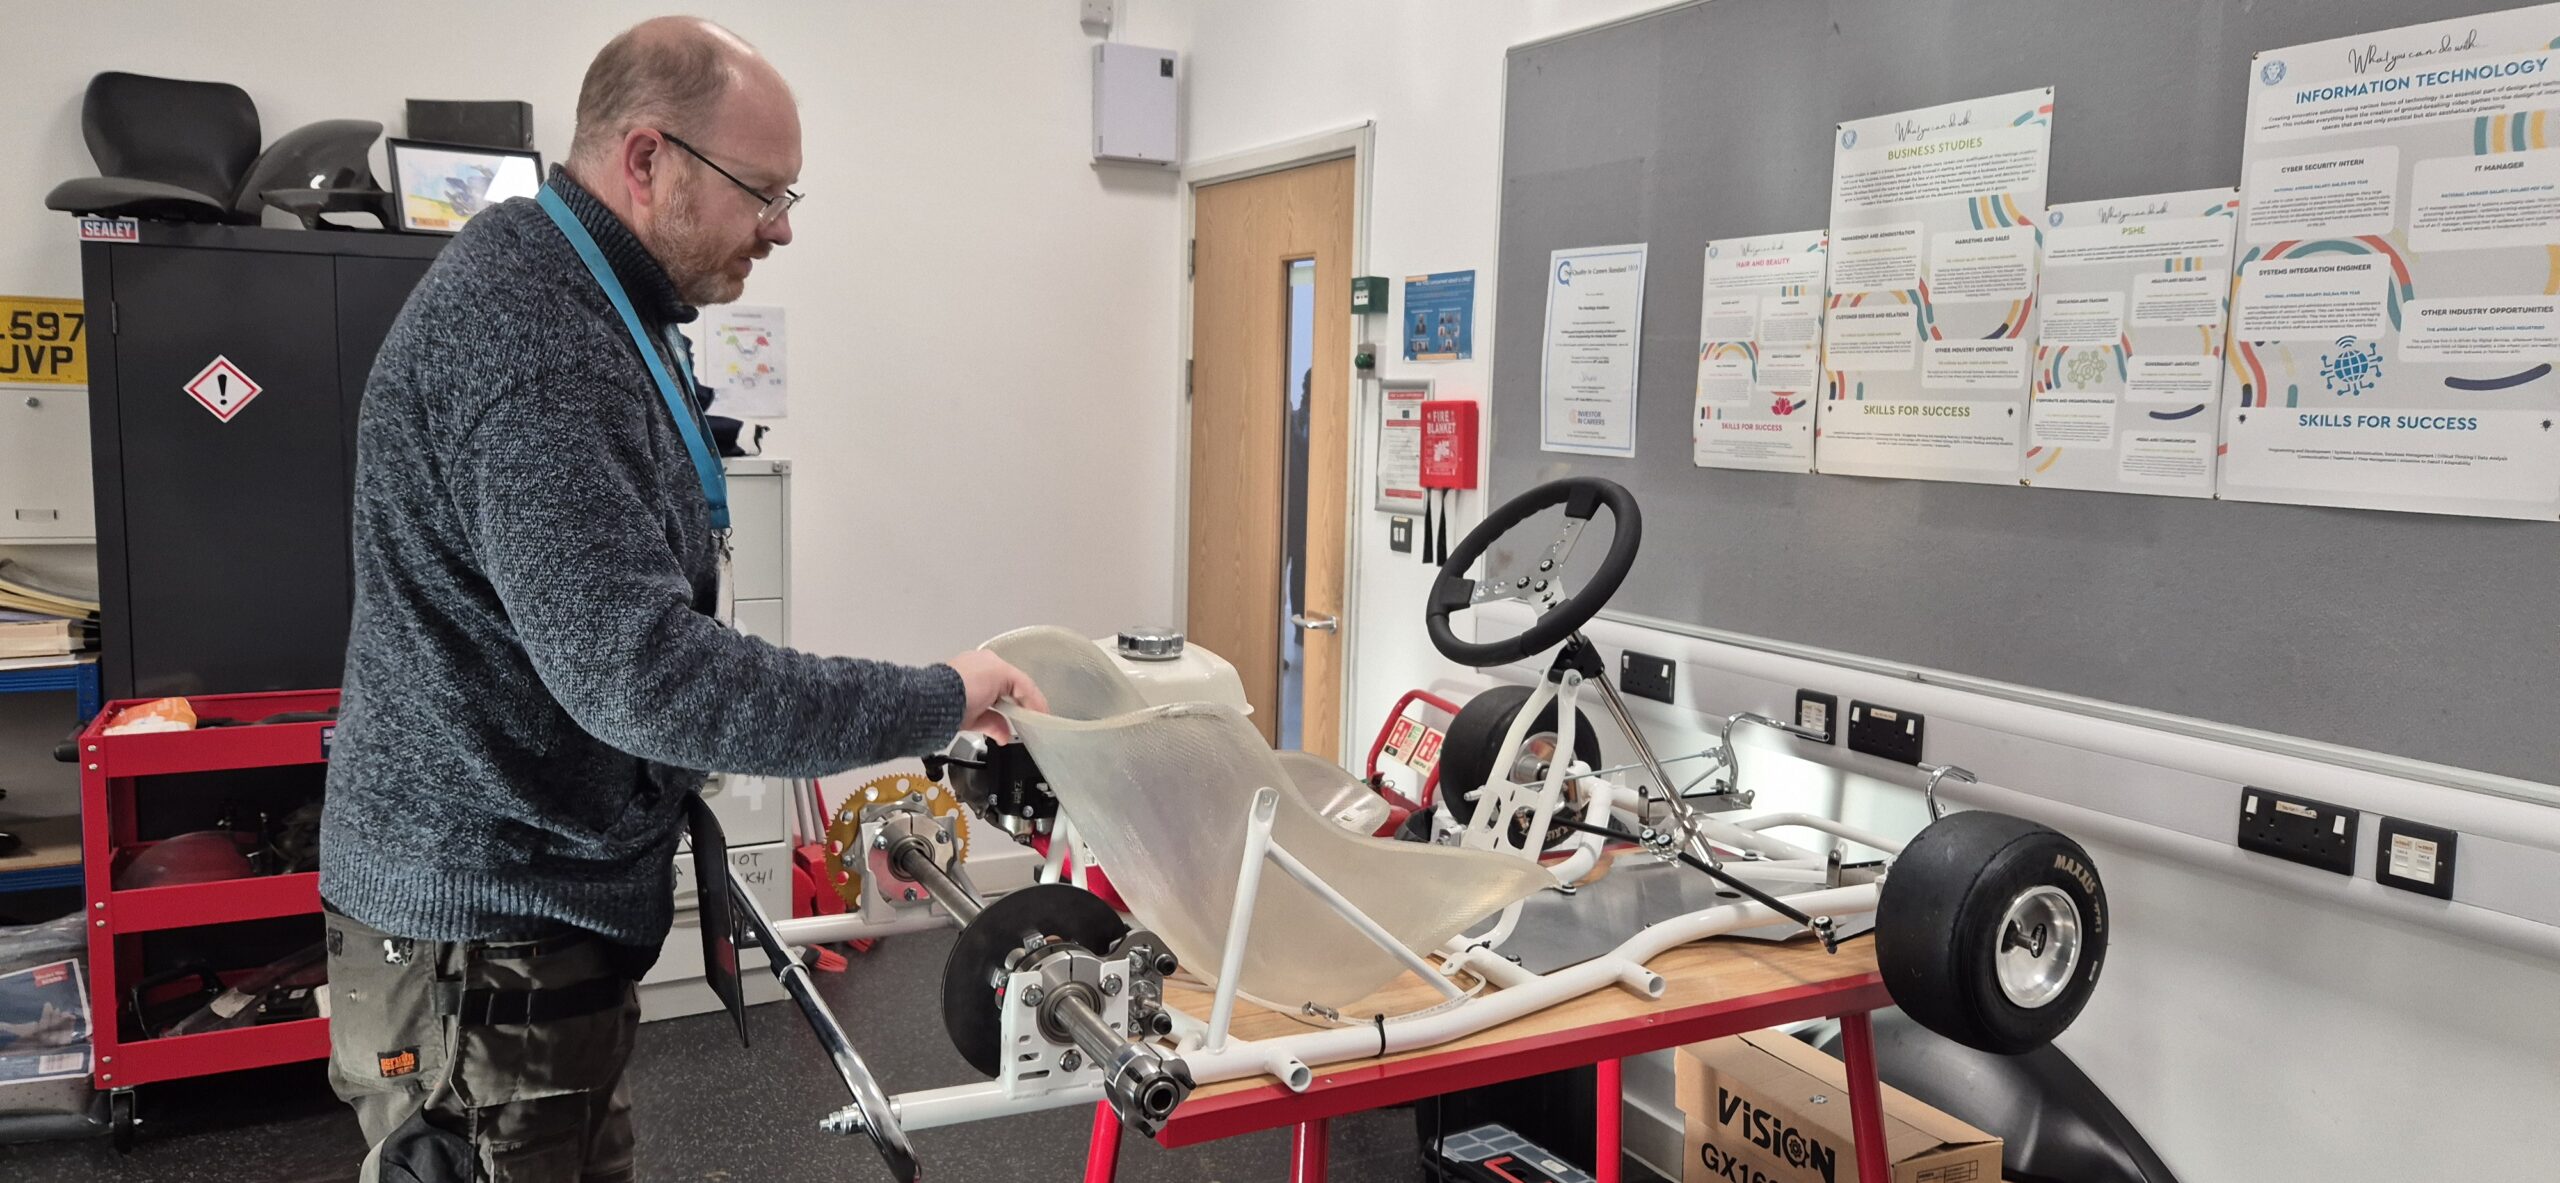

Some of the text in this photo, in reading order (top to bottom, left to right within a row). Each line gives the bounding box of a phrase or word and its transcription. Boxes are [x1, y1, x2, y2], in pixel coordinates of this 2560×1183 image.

[2385, 54, 2406, 72] you
[2408, 50, 2436, 59] can
[2438, 34, 2452, 54] do
[2296, 57, 2548, 104] INFORMATION TECHNOLOGY
[2292, 111, 2318, 119] innovative
[2344, 105, 2358, 113] using
[2404, 95, 2438, 104] technology
[2454, 89, 2481, 98] essential
[2483, 87, 2497, 95] part
[2506, 84, 2528, 92] design
[2294, 118, 2315, 126] includes
[2316, 115, 2344, 124] everything
[2369, 108, 2393, 116] creation
[2470, 97, 2490, 105] games
[2513, 91, 2535, 99] design
[2373, 117, 2386, 125] only
[2387, 114, 2412, 122] practical
[1888, 137, 1983, 161] BUSINESS STUDIES
[2305, 162, 2338, 171] SECURITY
[2339, 158, 2364, 167] INTERN
[2484, 161, 2524, 172] MANAGER
[84, 221, 131, 238] SEALEY
[2122, 226, 2146, 235] PSHE
[1736, 261, 1750, 269] HAIR
[1765, 257, 1790, 266] BEAUTY
[2259, 263, 2372, 277] SYSTEMS INTEGRATION ENGINEER
[2421, 305, 2554, 316] OTHER INDUSTRY OPPORTUNITIES
[0, 345, 73, 375] JVP
[1433, 411, 1449, 422] FIRE
[1864, 404, 1971, 418] SKILLS FOR SUCCESS
[1426, 422, 1456, 434] BLANKET
[1583, 418, 1605, 426] CAREERS
[1721, 422, 1783, 432] SKILLS FOR SUCCESS
[2299, 414, 2478, 430] SKILLS FOR SUCCESS
[2054, 854, 2098, 894] MAXXIS
